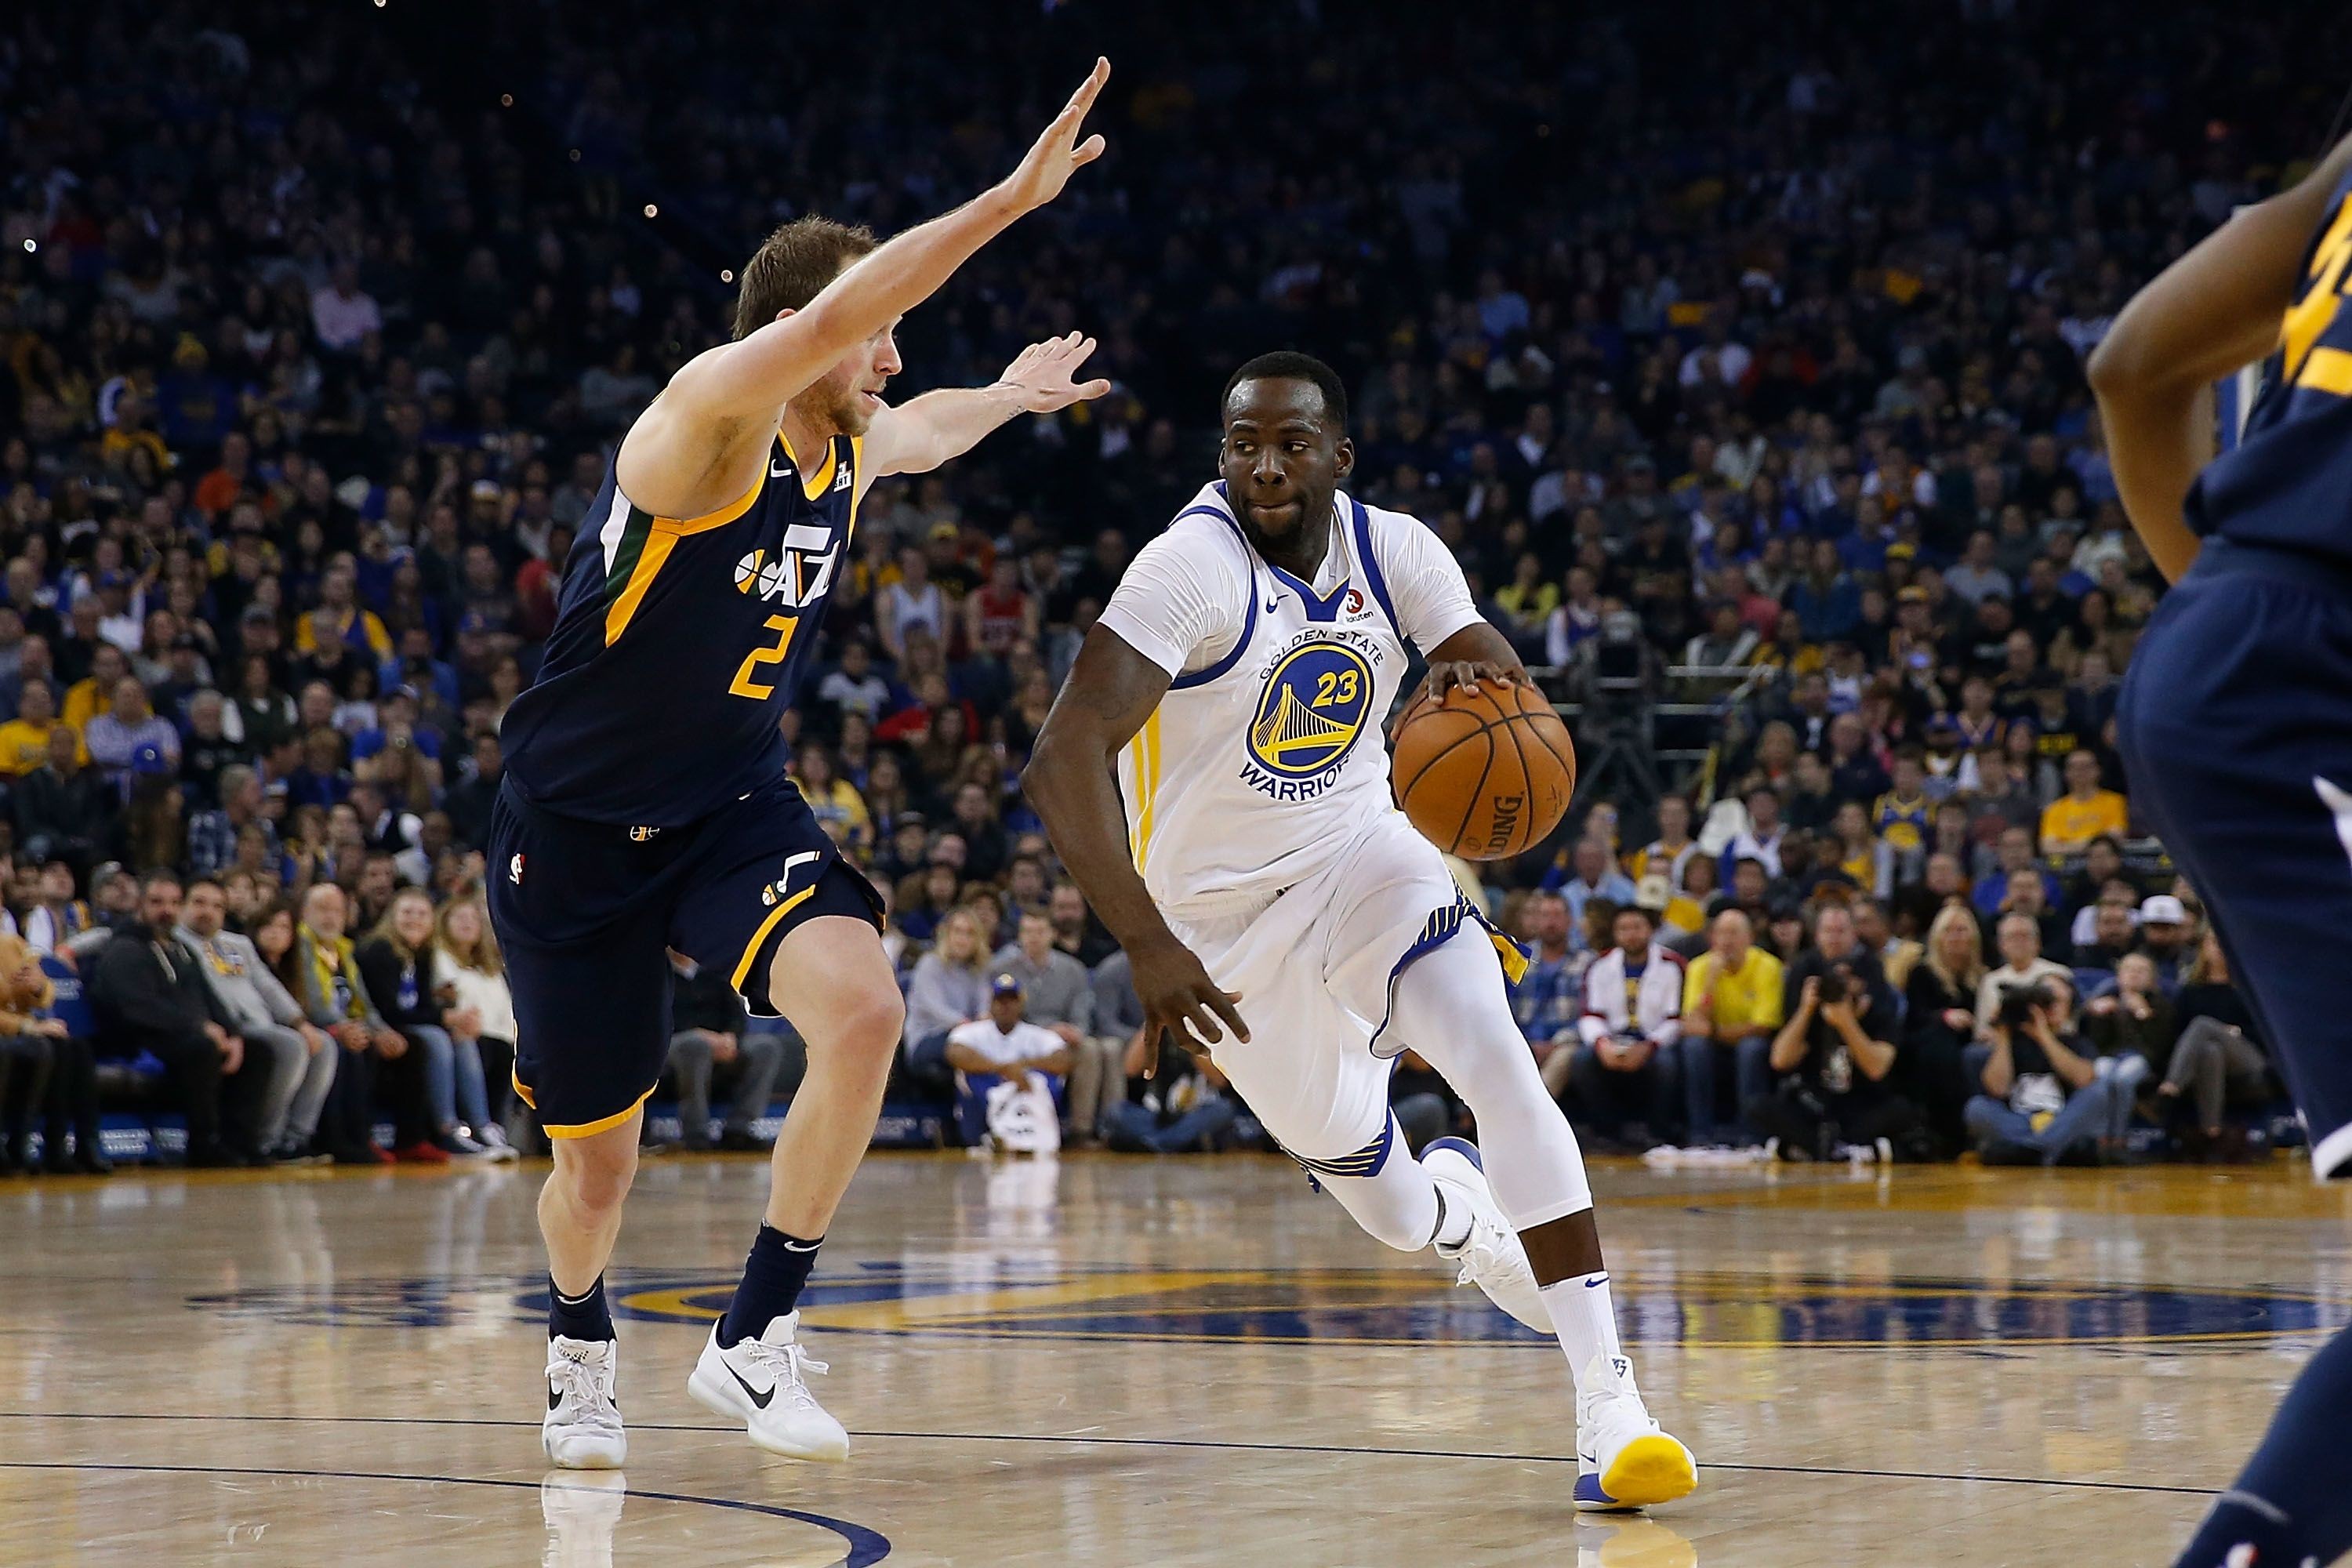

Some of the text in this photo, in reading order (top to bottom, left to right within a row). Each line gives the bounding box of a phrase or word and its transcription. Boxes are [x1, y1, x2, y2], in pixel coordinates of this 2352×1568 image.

[728, 614, 798, 699] 2
[1260, 630, 1384, 680] GOLDEN STATE
[1311, 669, 1359, 709] 23
